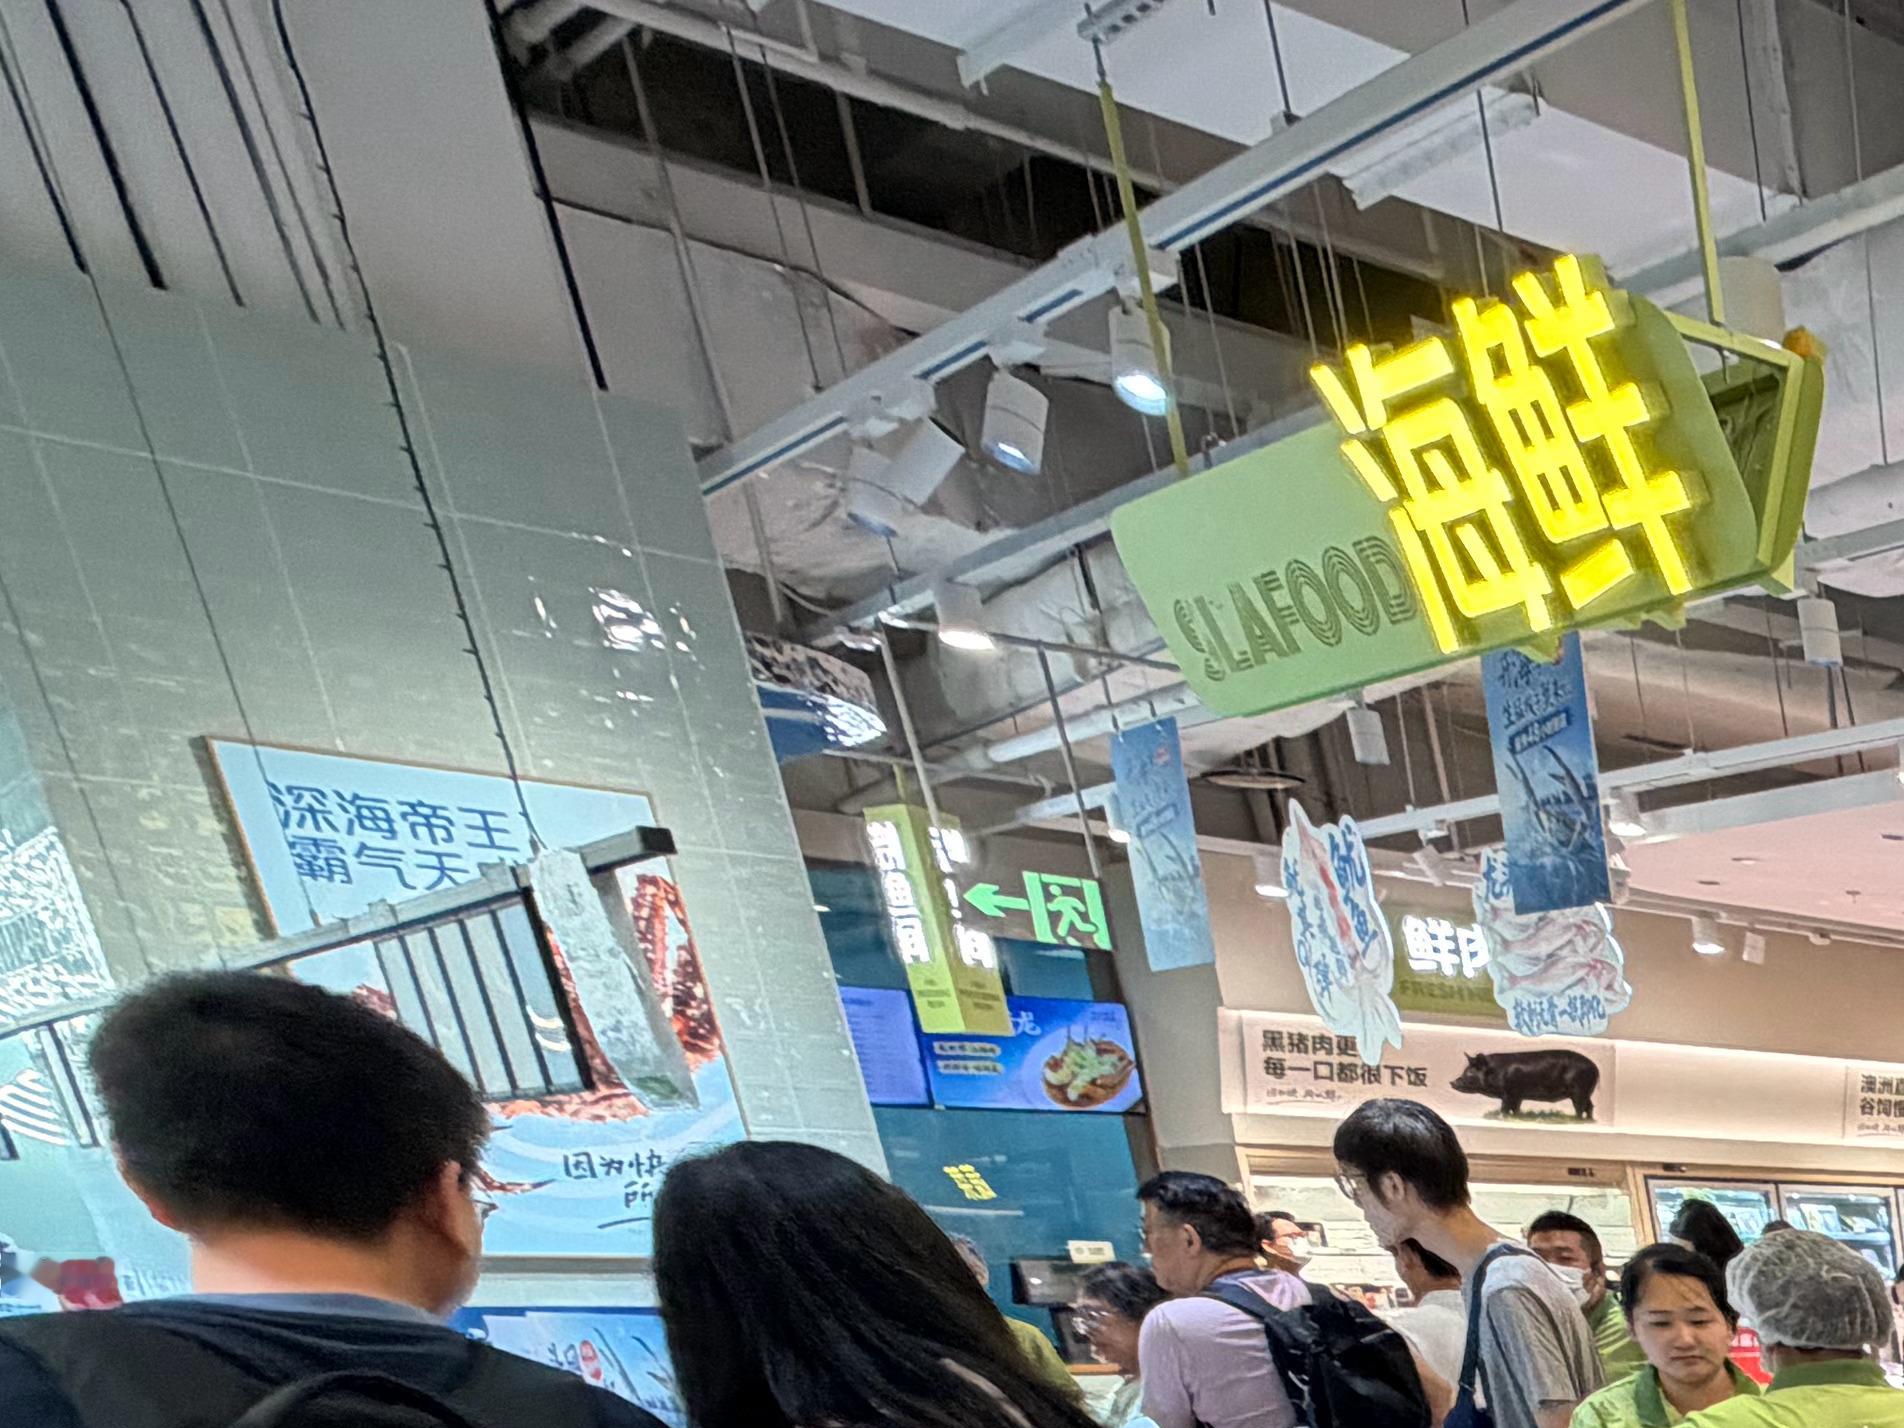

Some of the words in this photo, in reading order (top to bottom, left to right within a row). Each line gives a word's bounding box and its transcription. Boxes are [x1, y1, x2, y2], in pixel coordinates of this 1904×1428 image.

[1310, 252, 1693, 655] 海鲜
[267, 784, 518, 853] 深海帝王
[288, 836, 520, 890] 霸气天
[1264, 1057, 1427, 1087] 每一口都很下饭
